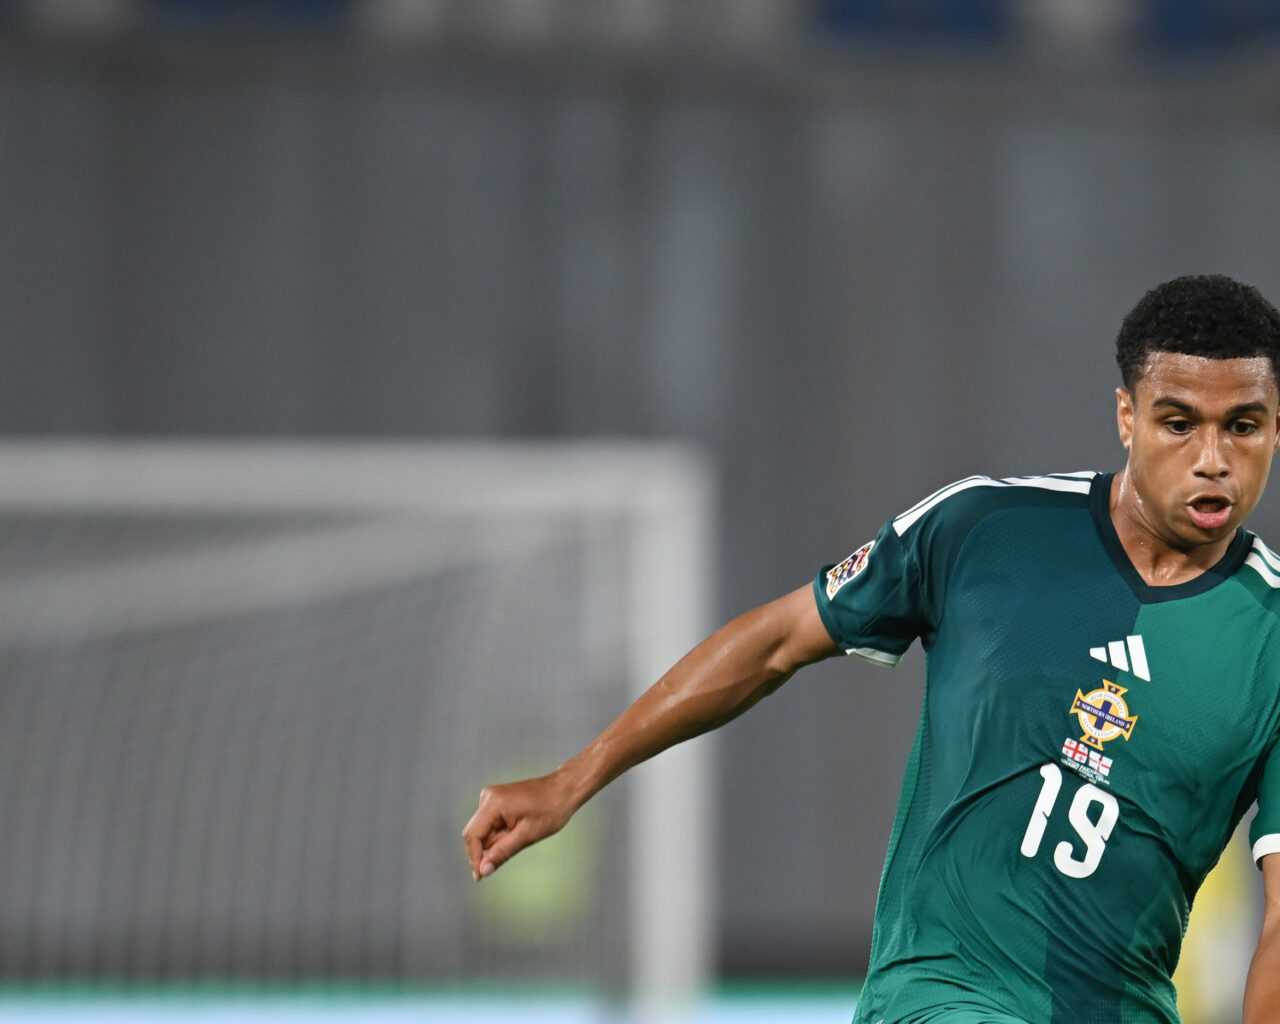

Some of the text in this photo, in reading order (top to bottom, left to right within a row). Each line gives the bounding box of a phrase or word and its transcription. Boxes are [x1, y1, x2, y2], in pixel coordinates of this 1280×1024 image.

[1081, 703, 1125, 727] NORTHERN IRELAND
[1020, 763, 1119, 878] 19
